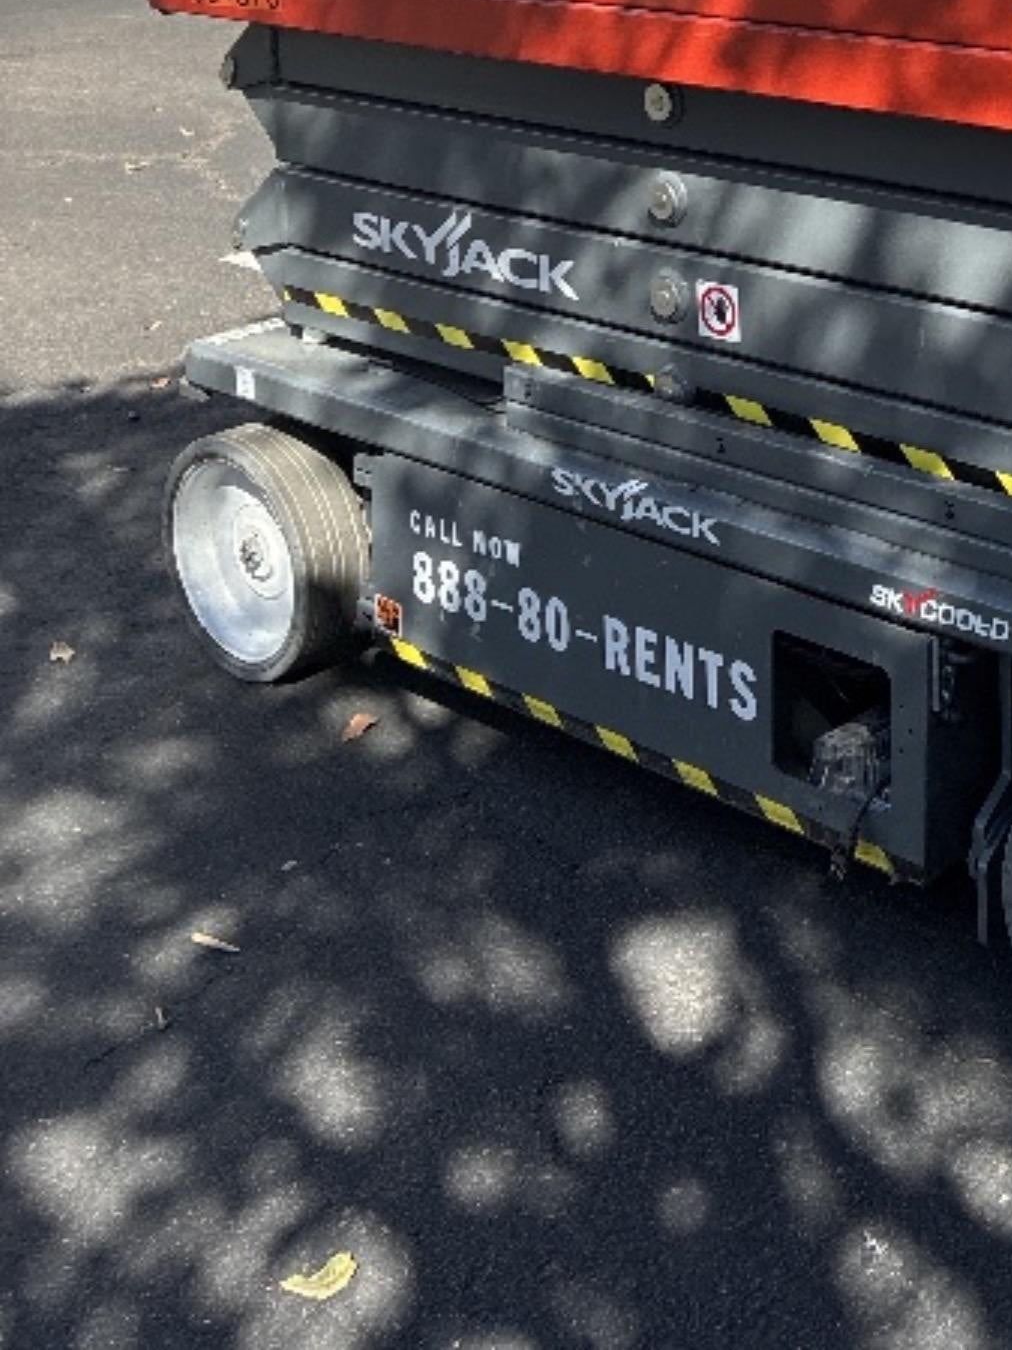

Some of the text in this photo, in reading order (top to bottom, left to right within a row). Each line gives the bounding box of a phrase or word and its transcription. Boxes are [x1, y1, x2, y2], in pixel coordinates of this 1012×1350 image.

[352, 210, 580, 301] SKYJACK
[410, 509, 521, 568] CALL NOW
[550, 467, 721, 547] SKYJACK
[413, 551, 759, 722] 888-80-RENTS
